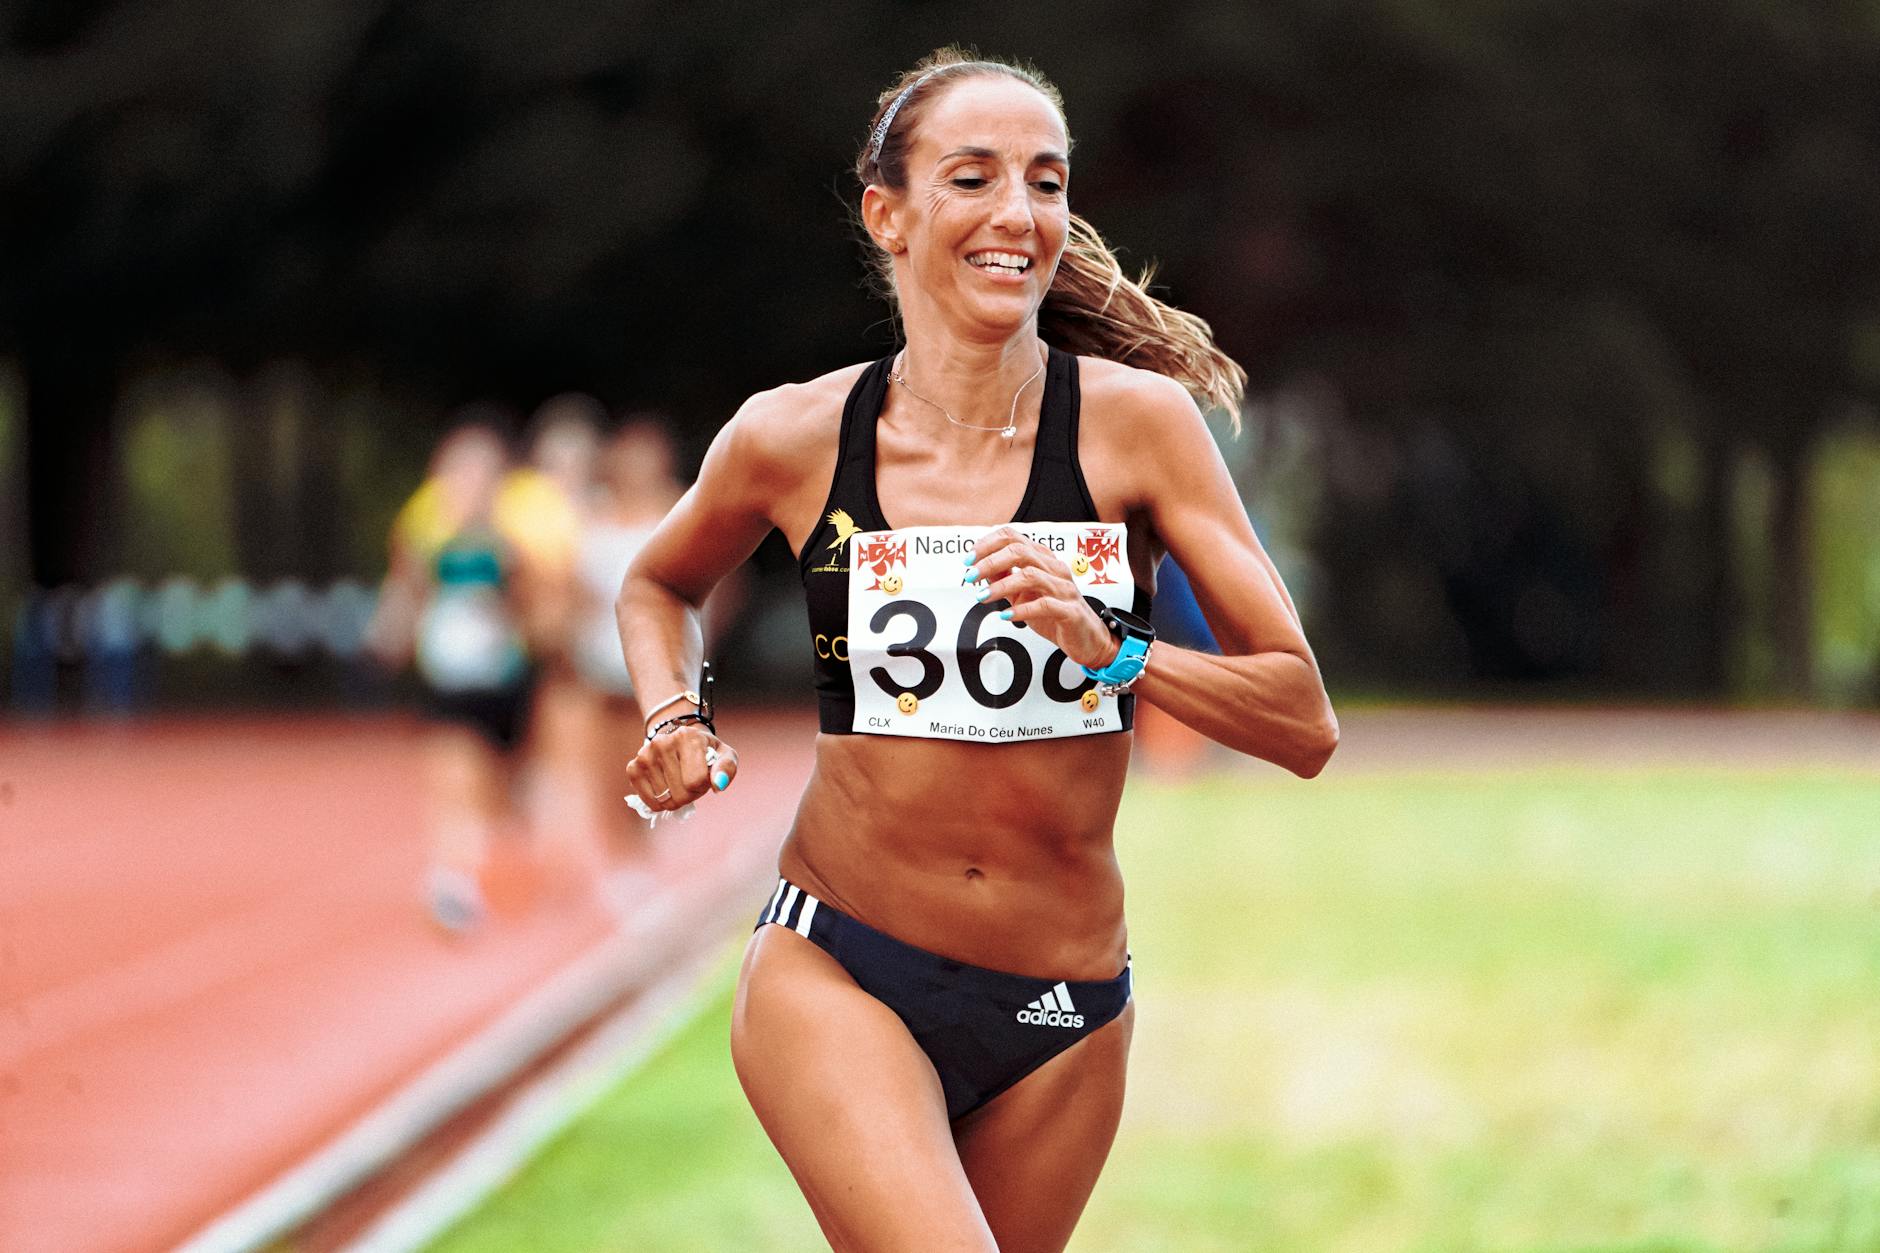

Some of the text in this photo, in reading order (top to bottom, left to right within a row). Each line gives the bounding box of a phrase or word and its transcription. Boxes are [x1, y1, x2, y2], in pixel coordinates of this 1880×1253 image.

[916, 532, 1065, 554] Nacio ista
[868, 716, 892, 728] CLX
[929, 721, 1053, 738] Maria Do Céu Nunes
[1082, 717, 1105, 729] W40
[1016, 1008, 1085, 1028] adidas
